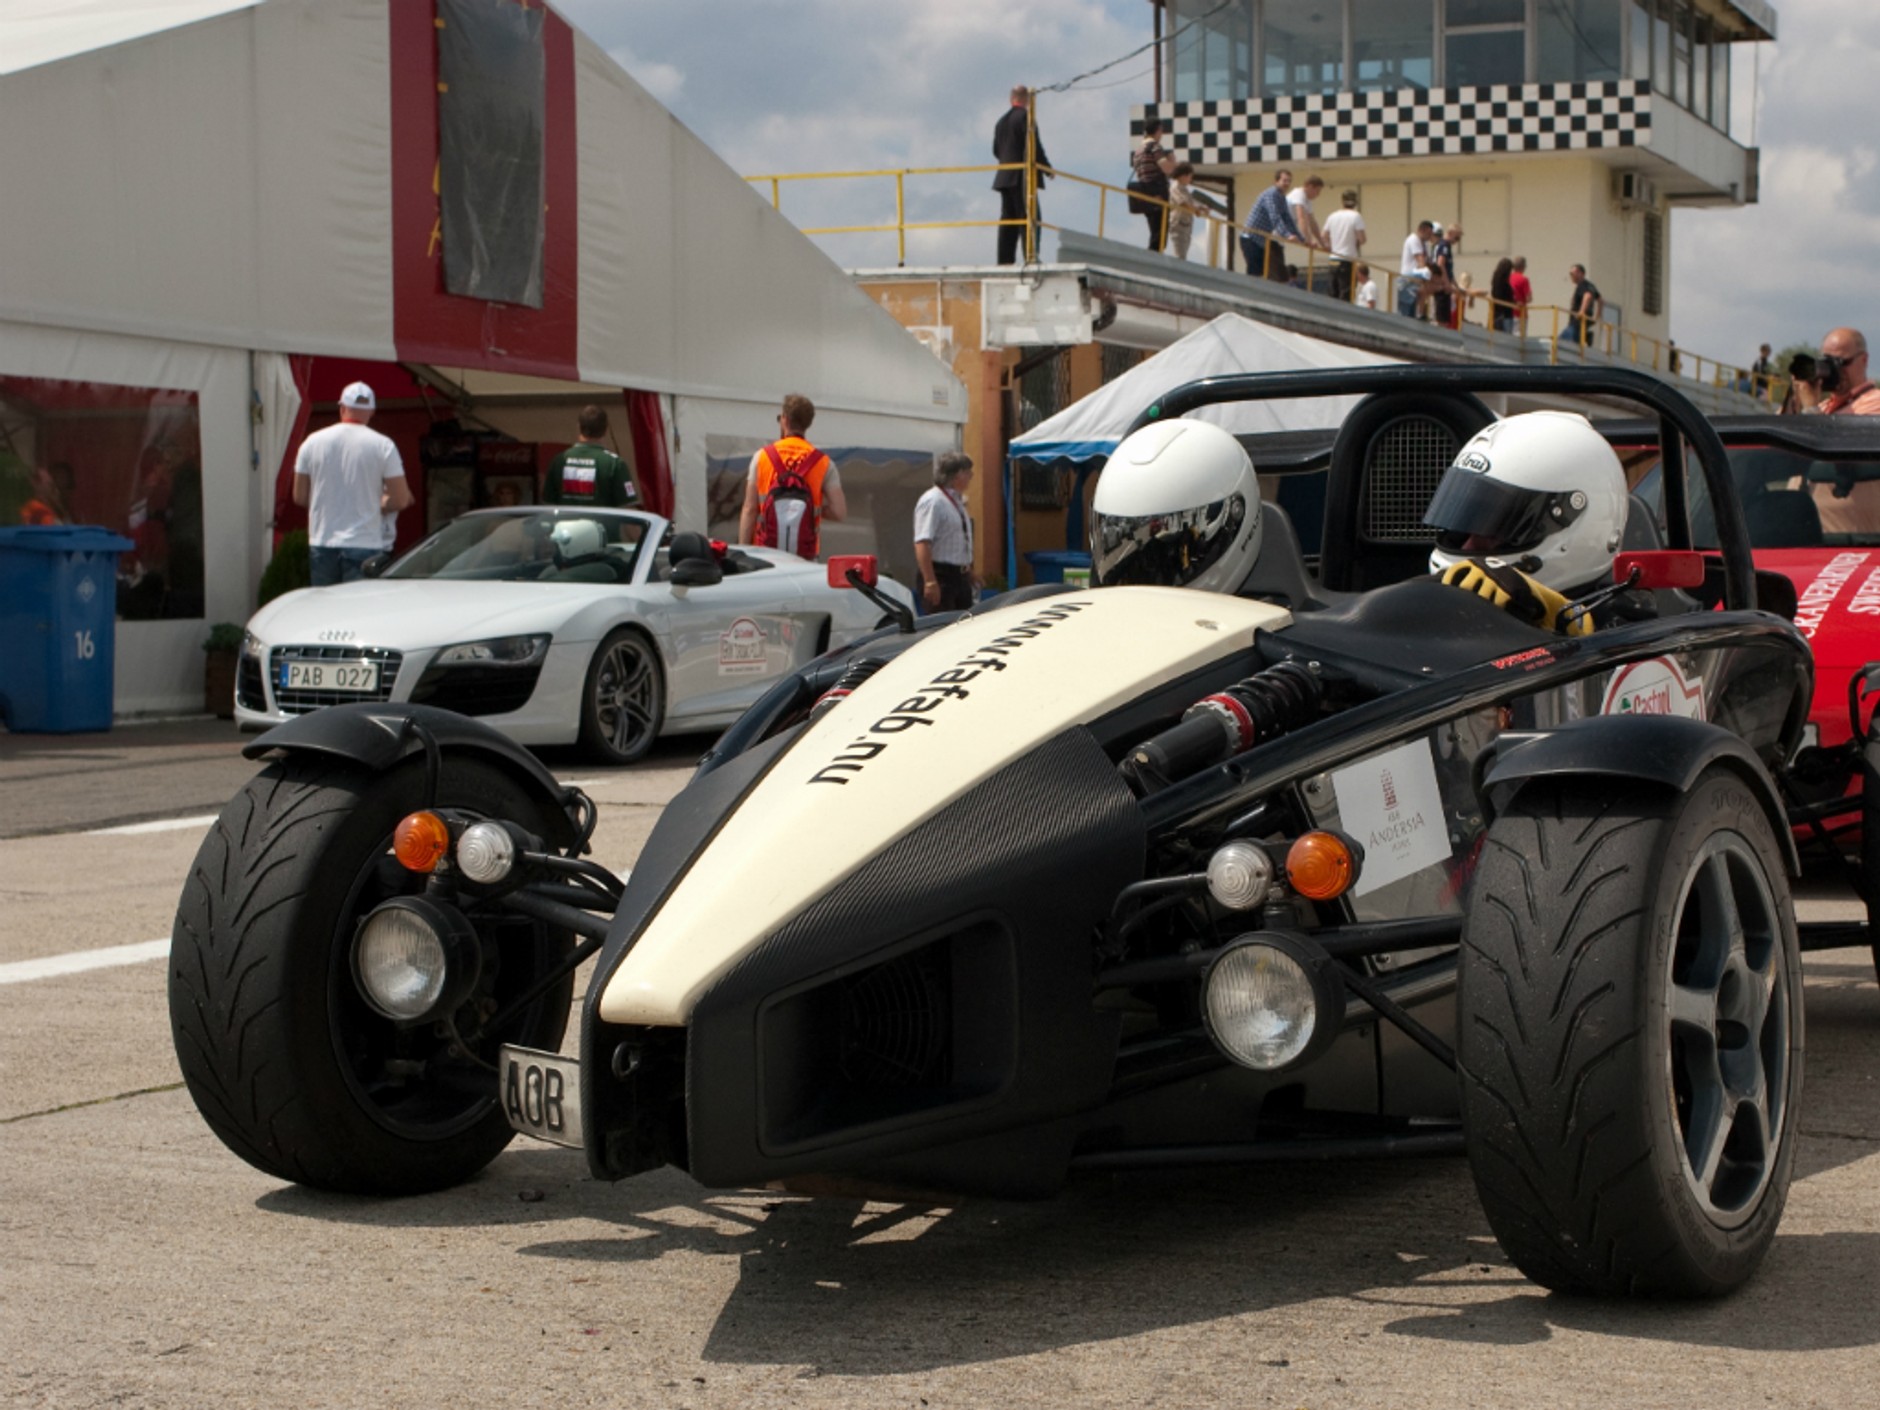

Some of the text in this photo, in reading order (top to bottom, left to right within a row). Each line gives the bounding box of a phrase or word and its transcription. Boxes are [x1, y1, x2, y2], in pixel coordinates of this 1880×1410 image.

[75, 630, 96, 659] 16
[290, 666, 373, 687] PAB 027
[806, 601, 1093, 785] www.fafab.nu
[1369, 811, 1426, 849] ANDERSIA
